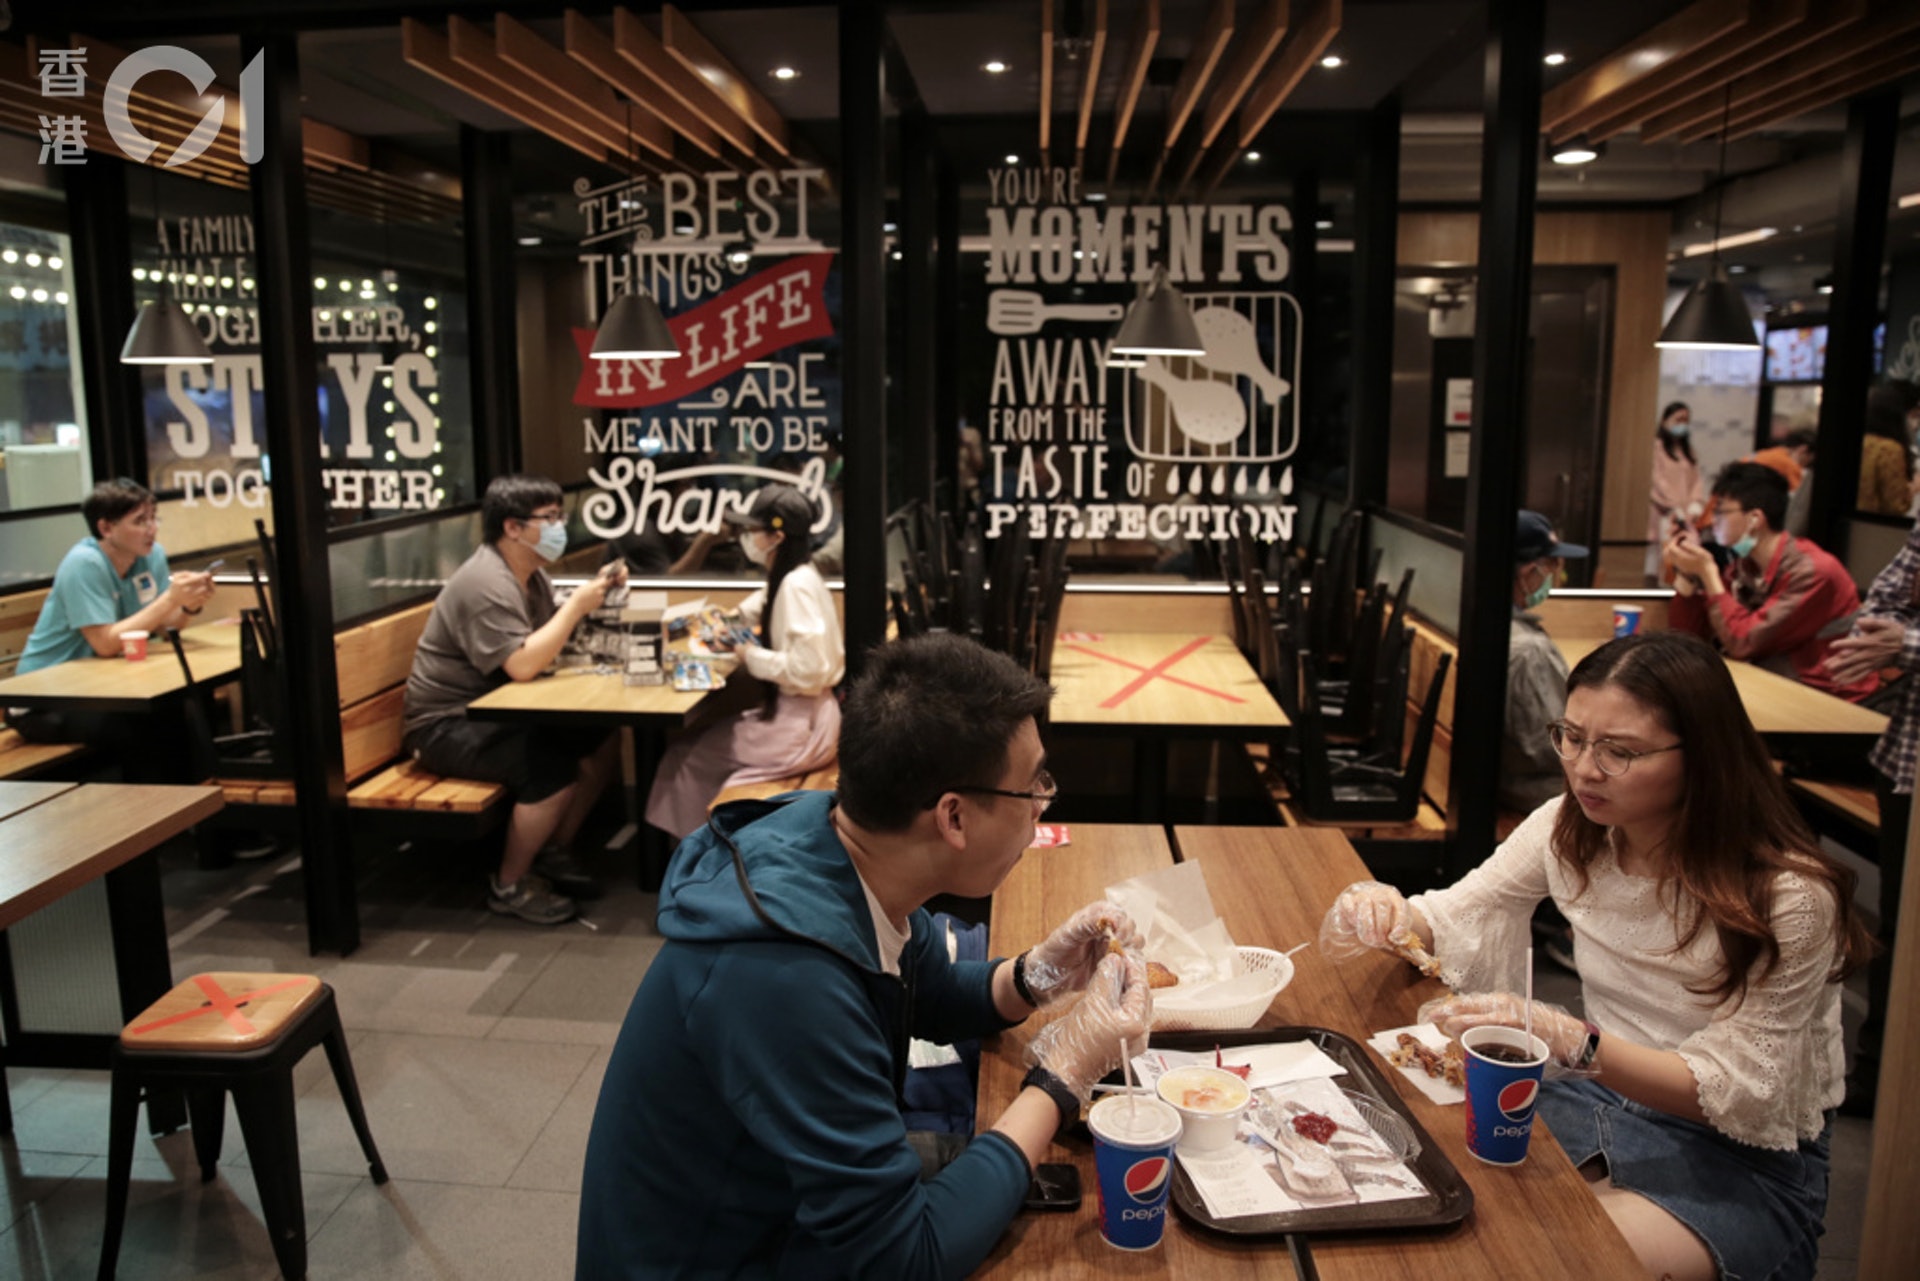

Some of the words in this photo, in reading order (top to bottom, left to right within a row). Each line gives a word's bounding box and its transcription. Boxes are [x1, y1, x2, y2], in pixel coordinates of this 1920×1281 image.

[578, 183, 650, 238] THE
[660, 168, 825, 243] BEST
[179, 215, 255, 254] FAMILY
[985, 205, 1293, 284] MOMENTS
[579, 253, 723, 322] THINGS
[685, 269, 813, 378] LIFE
[732, 352, 827, 409] ARE
[990, 338, 1114, 406] AWAY
[166, 353, 438, 459] STYS
[583, 417, 718, 454] MEANT
[730, 416, 774, 452] TO
[782, 415, 829, 452] BE
[988, 407, 1053, 441] FROM
[1066, 407, 1107, 441] THE
[174, 469, 440, 510] TOGHER
[989, 445, 1109, 499] TASTE
[1126, 463, 1155, 497] OF
[985, 504, 1298, 540] PERFECTION
